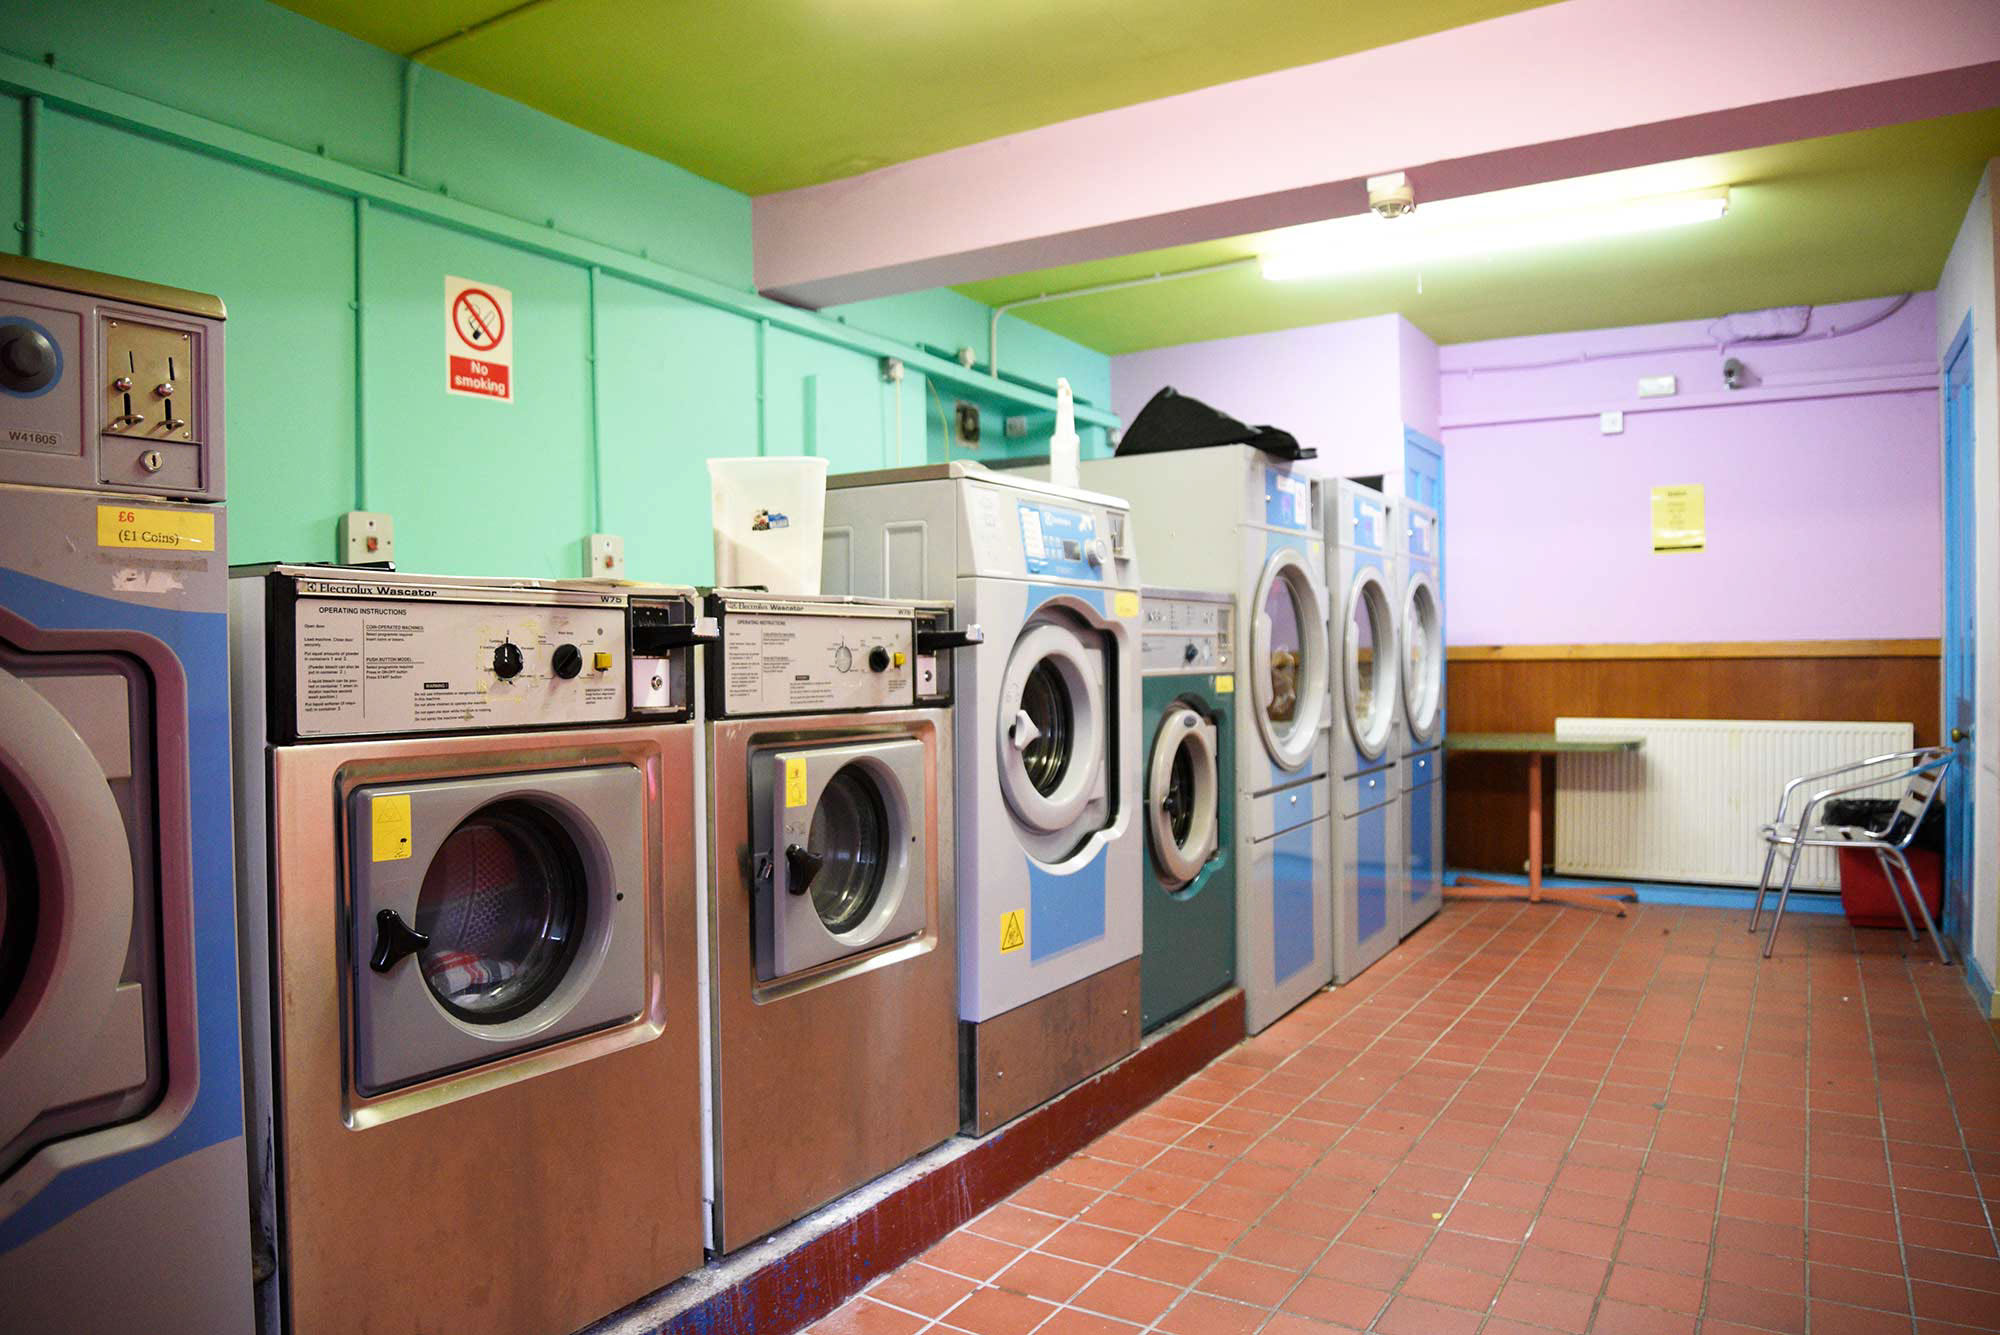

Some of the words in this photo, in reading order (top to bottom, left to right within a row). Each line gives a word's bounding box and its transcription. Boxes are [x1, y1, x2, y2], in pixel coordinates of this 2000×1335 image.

[471, 361, 488, 376] No
[455, 375, 505, 395] smoking
[9, 431, 57, 445] W4180S
[118, 511, 135, 523] £6
[118, 529, 137, 543] (£1
[141, 531, 180, 546] Coins)
[320, 583, 373, 595] Electrolux
[376, 587, 437, 597] Wascator
